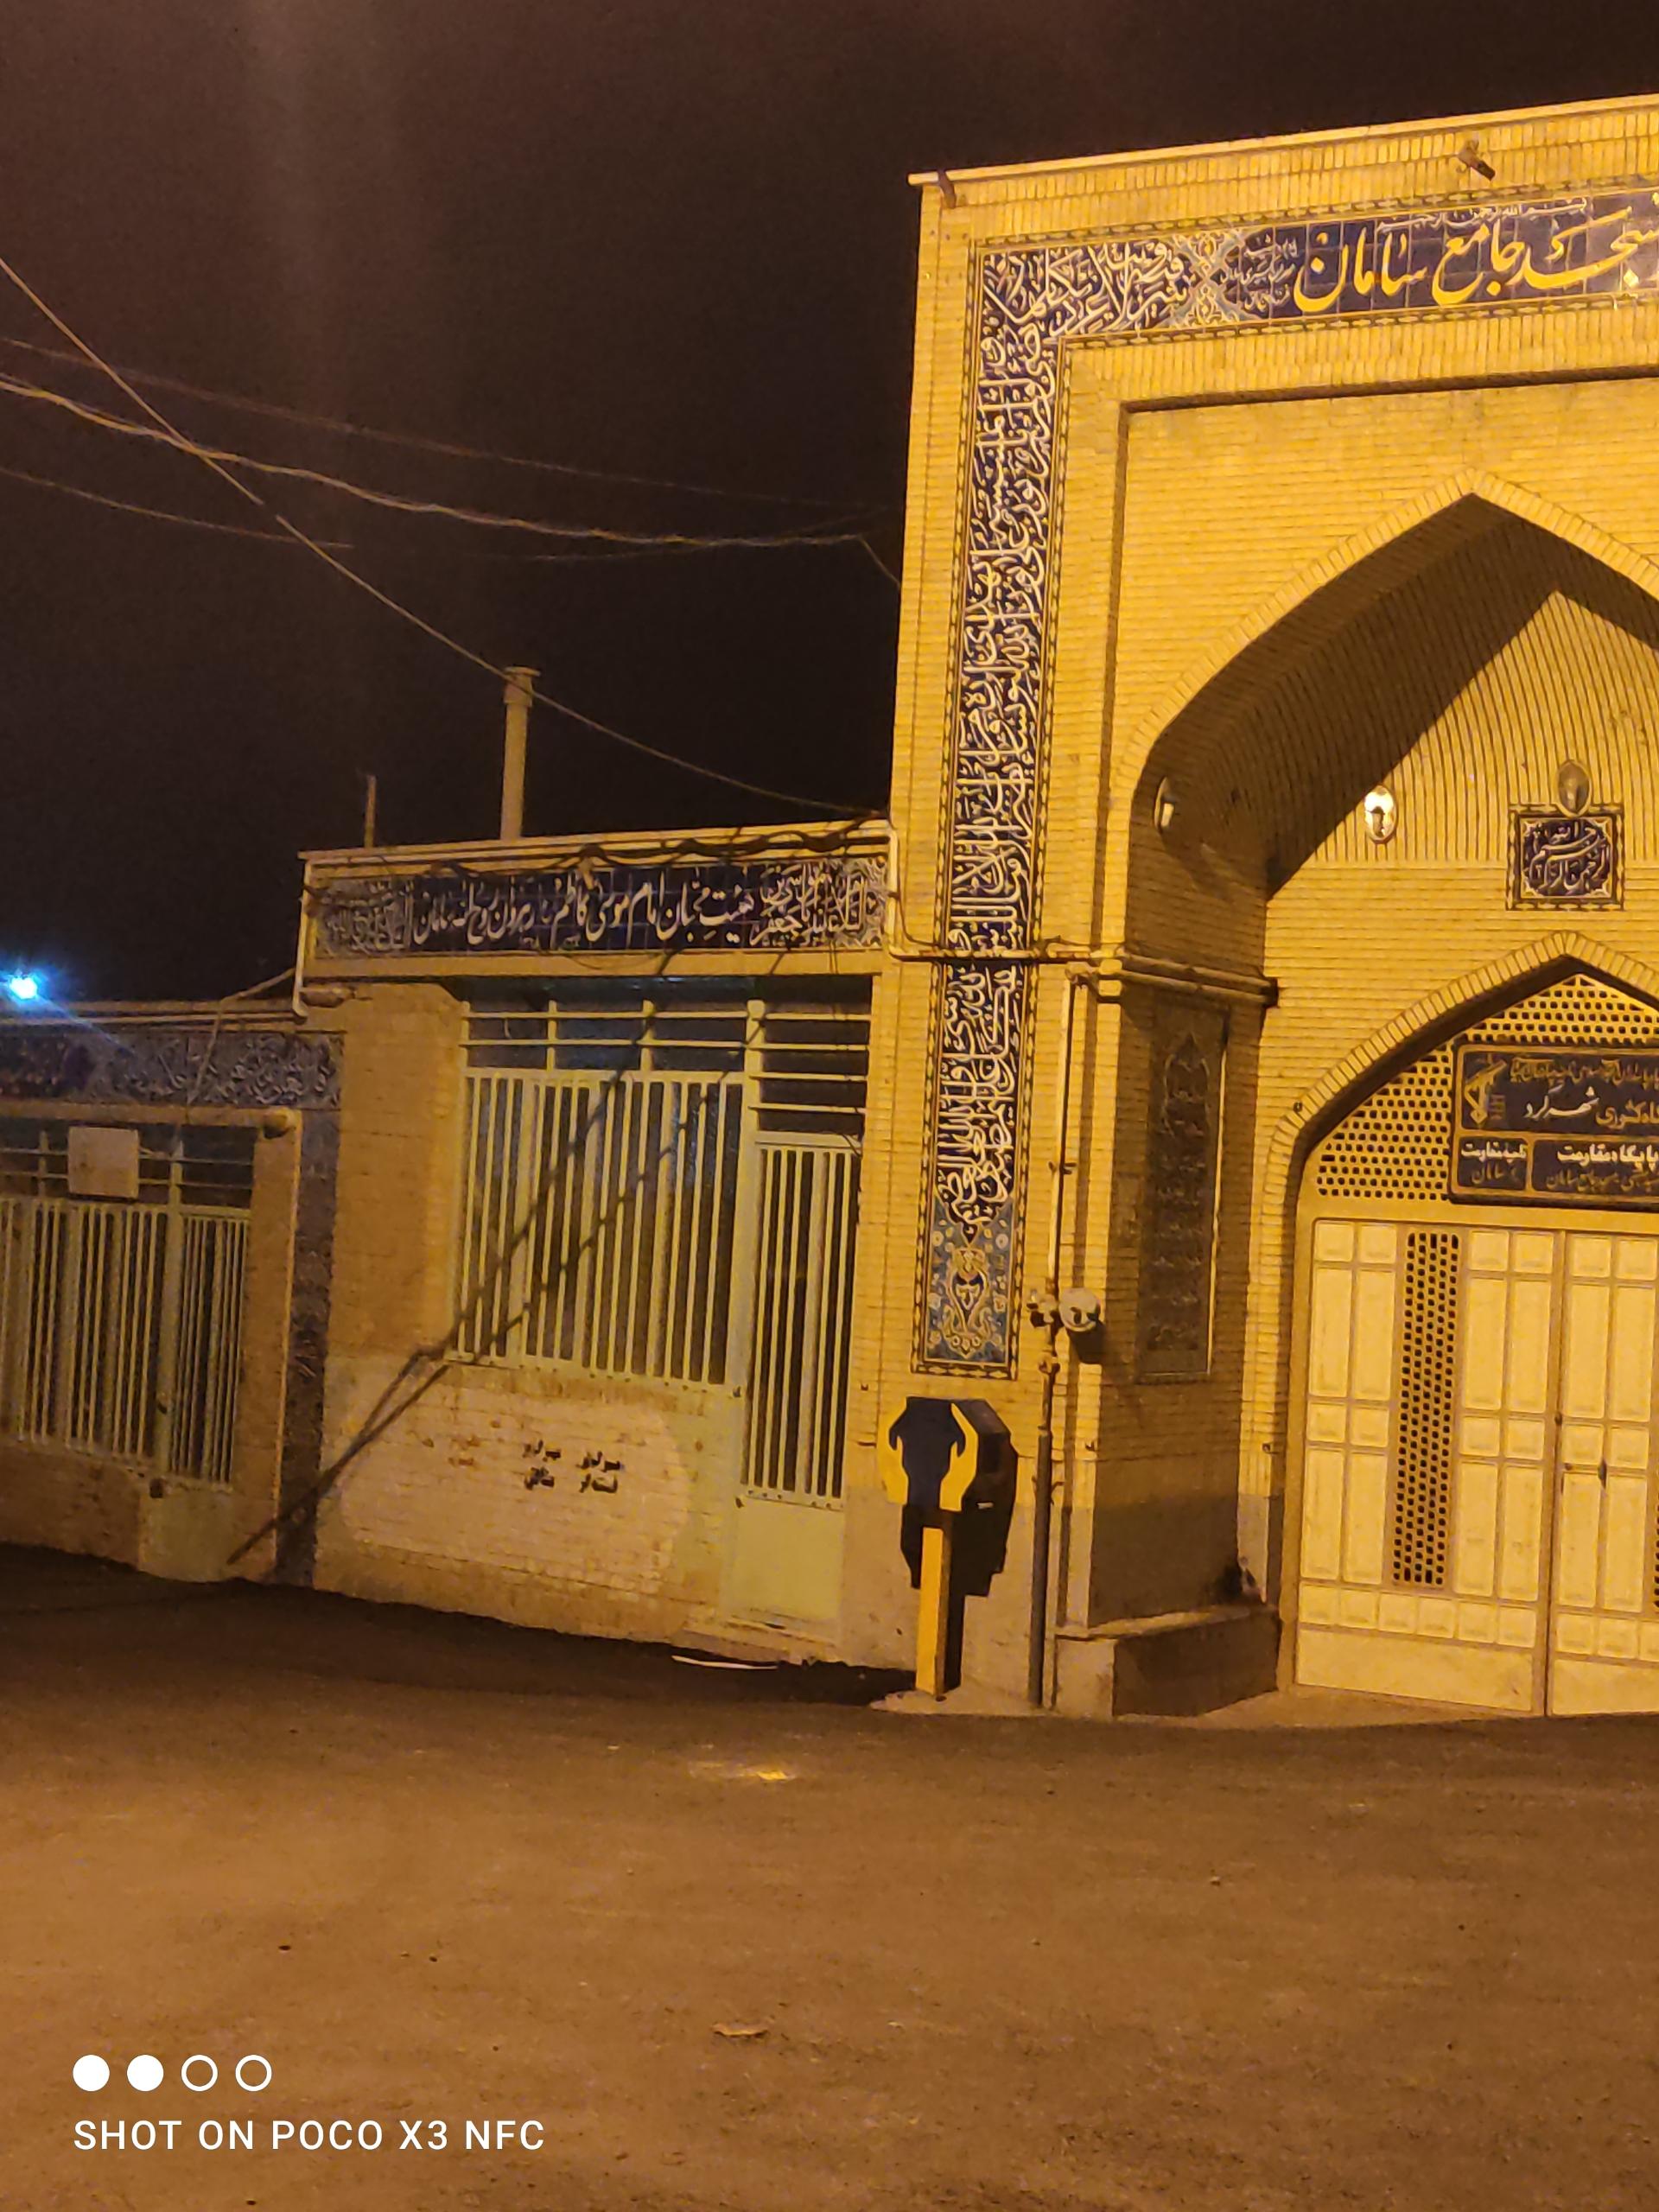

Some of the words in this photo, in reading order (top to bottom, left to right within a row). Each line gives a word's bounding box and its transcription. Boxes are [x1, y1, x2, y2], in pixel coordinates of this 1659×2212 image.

[1294, 225, 1427, 313] سامان
[1431, 219, 1525, 305] جامع
[1557, 1143, 1610, 1166] مقاومت
